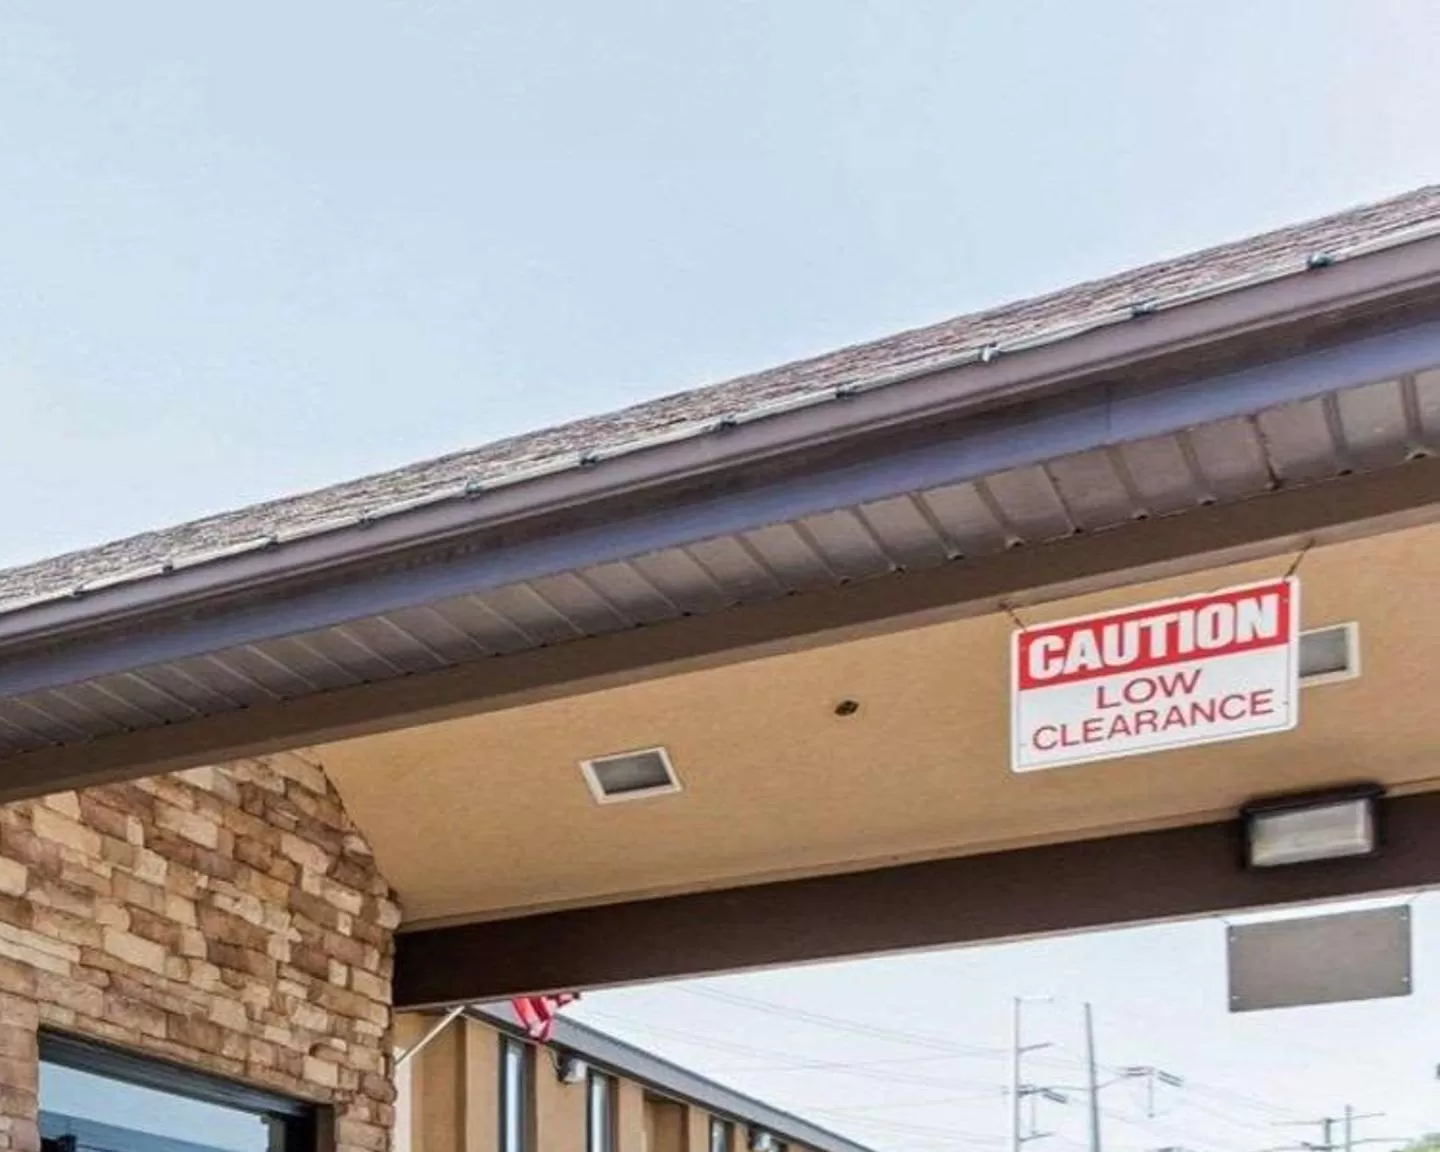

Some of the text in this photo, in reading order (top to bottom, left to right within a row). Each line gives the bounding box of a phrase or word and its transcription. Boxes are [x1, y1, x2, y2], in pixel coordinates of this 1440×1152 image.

[1028, 593, 1280, 680] CAUTION
[1097, 668, 1203, 709] LOW
[1032, 689, 1274, 750] CLEARANCE
